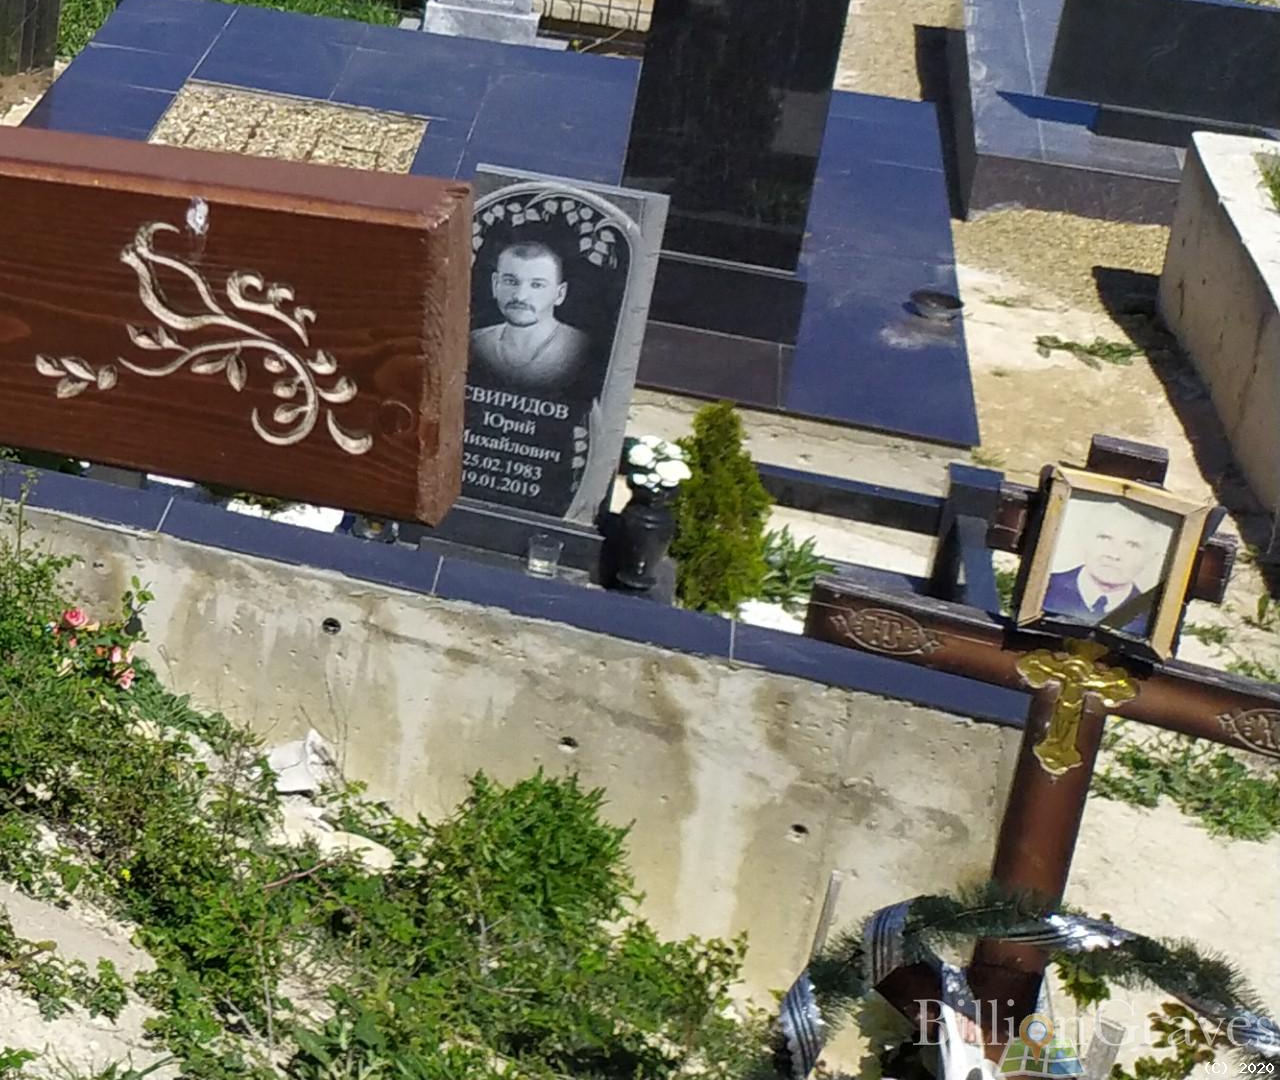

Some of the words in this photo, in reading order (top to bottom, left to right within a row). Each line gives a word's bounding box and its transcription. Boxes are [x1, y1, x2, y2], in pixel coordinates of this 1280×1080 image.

[463, 384, 570, 420] СВИРИДОВ
[483, 411, 537, 436] Юрий
[462, 452, 543, 481] 25.02.1983
[461, 469, 541, 497] 19.01.2019
